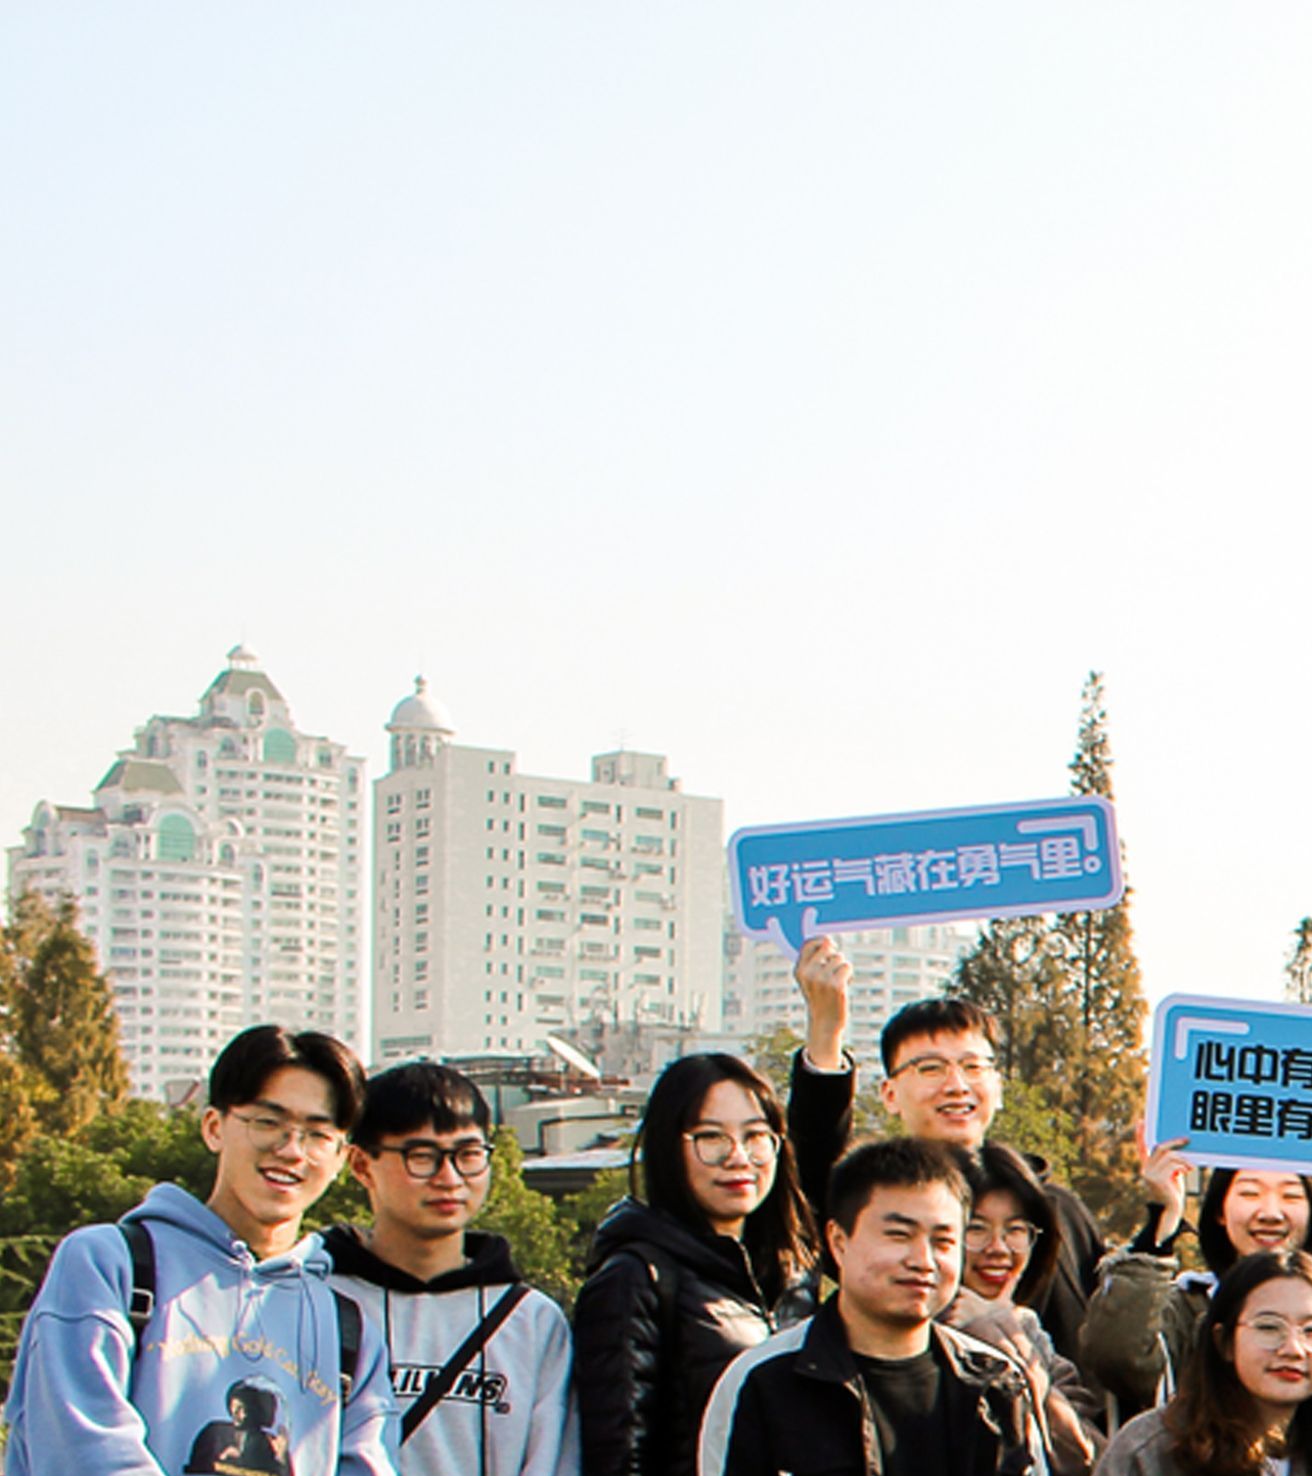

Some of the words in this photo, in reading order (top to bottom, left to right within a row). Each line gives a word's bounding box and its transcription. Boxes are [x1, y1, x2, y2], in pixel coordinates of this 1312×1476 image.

[748, 837, 1101, 908] 好运气藏在勇气里。
